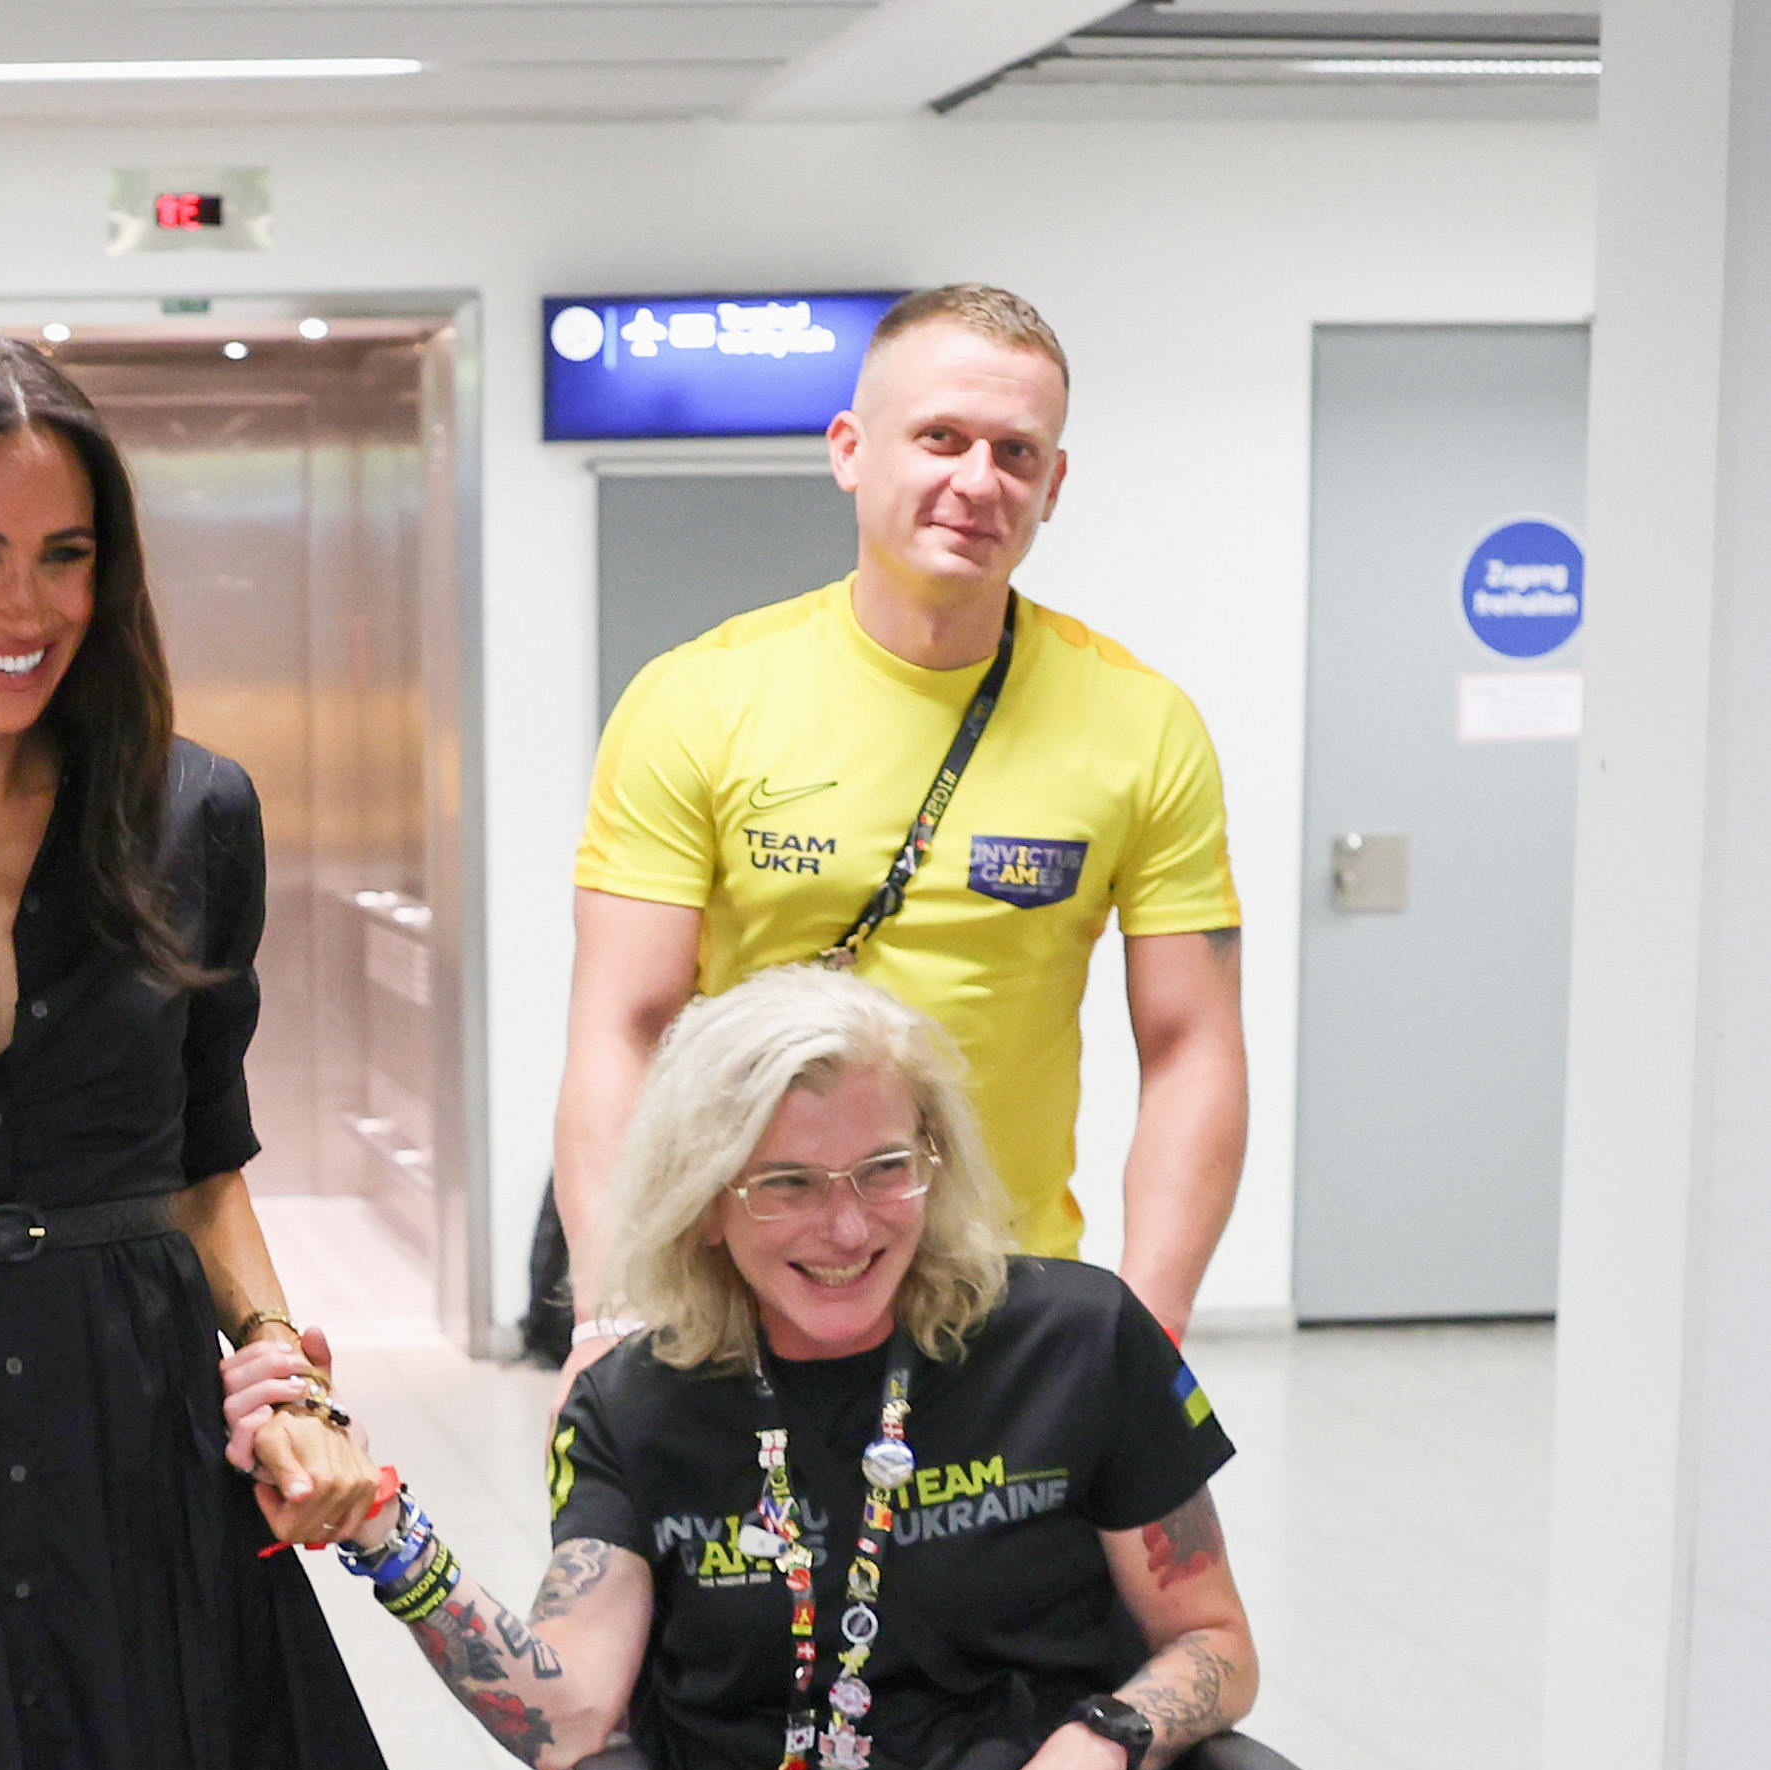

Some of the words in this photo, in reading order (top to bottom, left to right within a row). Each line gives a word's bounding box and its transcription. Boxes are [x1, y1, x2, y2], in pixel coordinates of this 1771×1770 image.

[742, 826, 836, 854] TEAM
[751, 851, 820, 875] UKR
[971, 843, 1082, 868] INVICTUS
[980, 863, 1064, 887] GAMES
[894, 1454, 1006, 1510] TEAM
[893, 1478, 1069, 1546] UKRAINE
